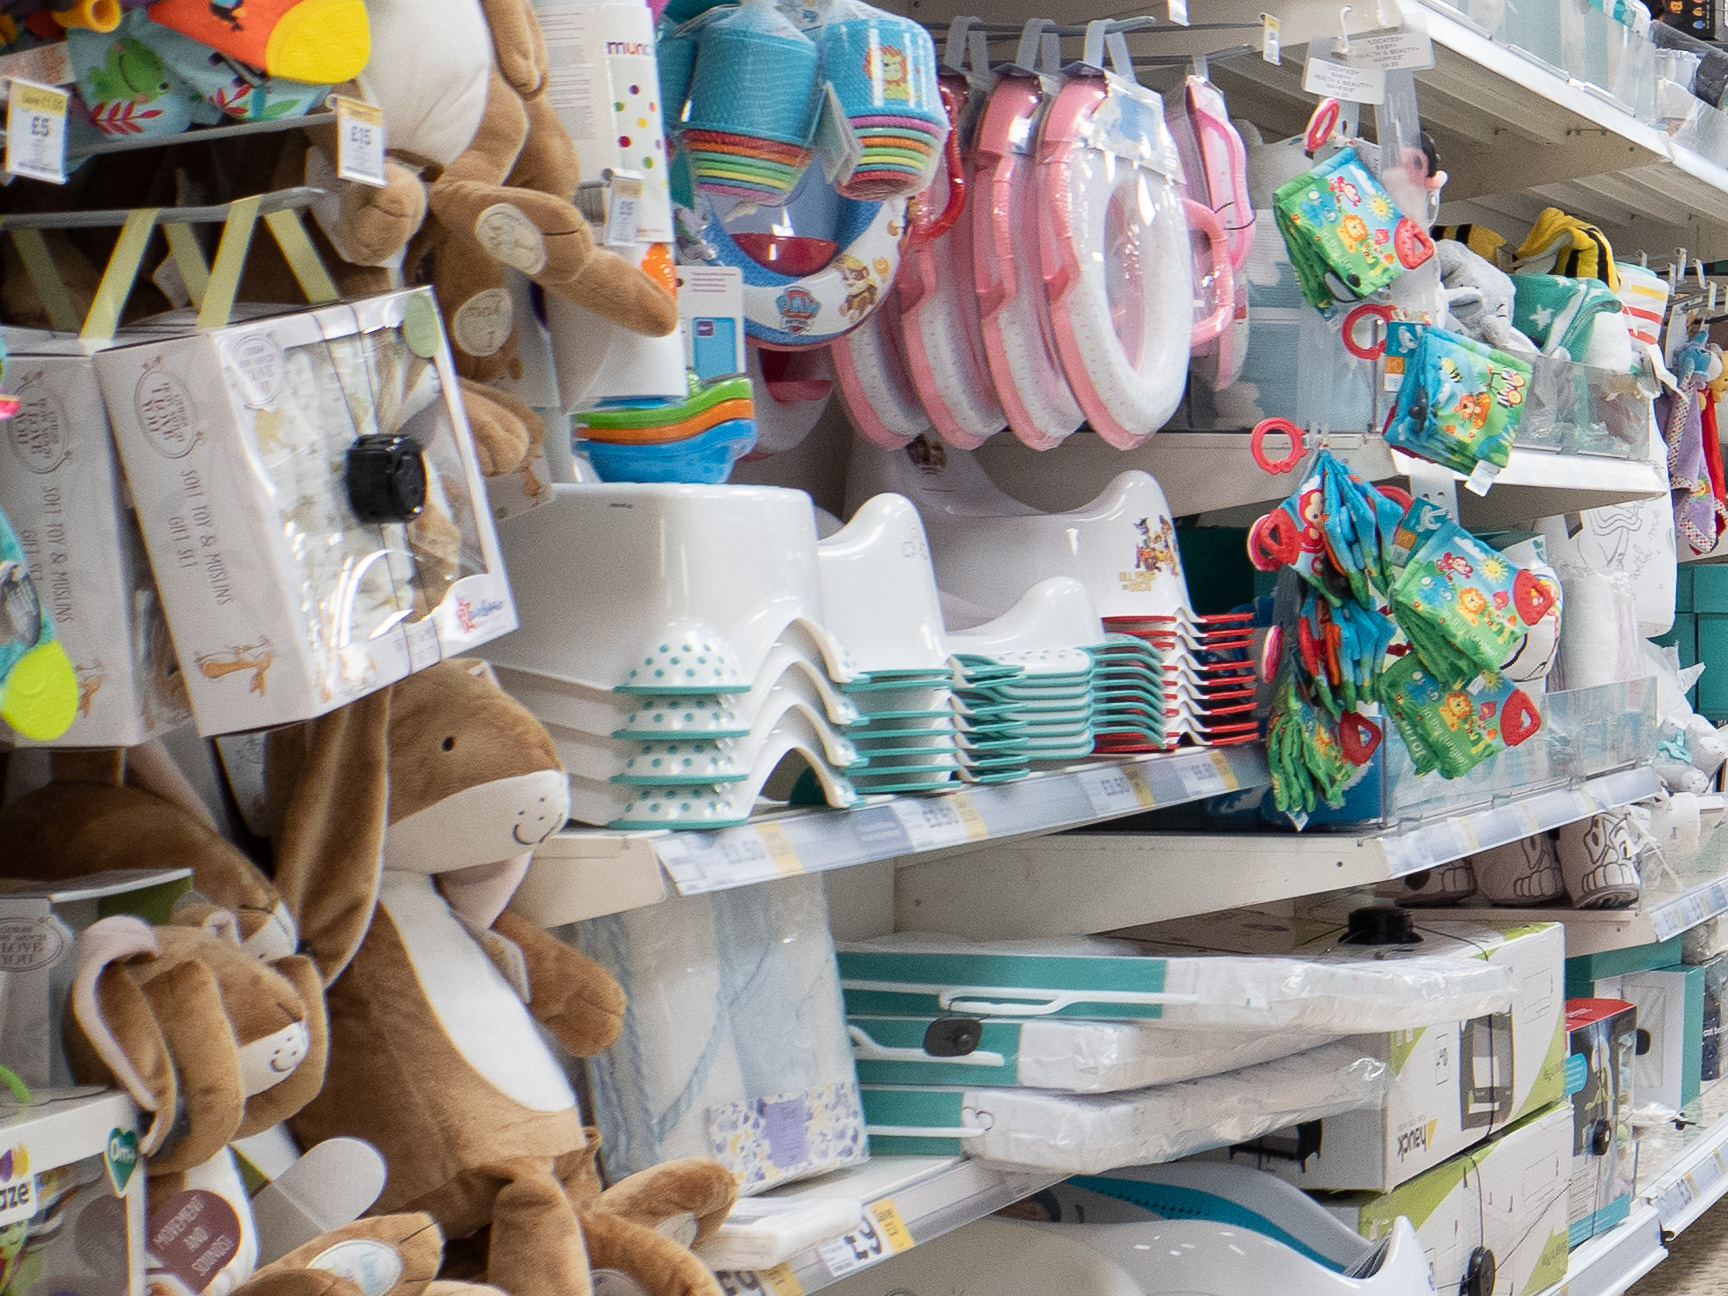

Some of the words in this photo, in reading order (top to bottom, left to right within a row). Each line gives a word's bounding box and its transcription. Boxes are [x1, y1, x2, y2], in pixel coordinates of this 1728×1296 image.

[31, 115, 50, 138] £5
[181, 469, 201, 500] SOFT
[42, 486, 59, 518] SOFT
[189, 502, 208, 531] TOY
[47, 520, 66, 549] TOY
[167, 516, 183, 543] GIFT
[176, 545, 197, 571] SET
[204, 550, 233, 607] MUSLINS
[55, 569, 76, 625] MUSLINS
[154, 1194, 206, 1252] MOVEMENT
[182, 1230, 209, 1252] AND
